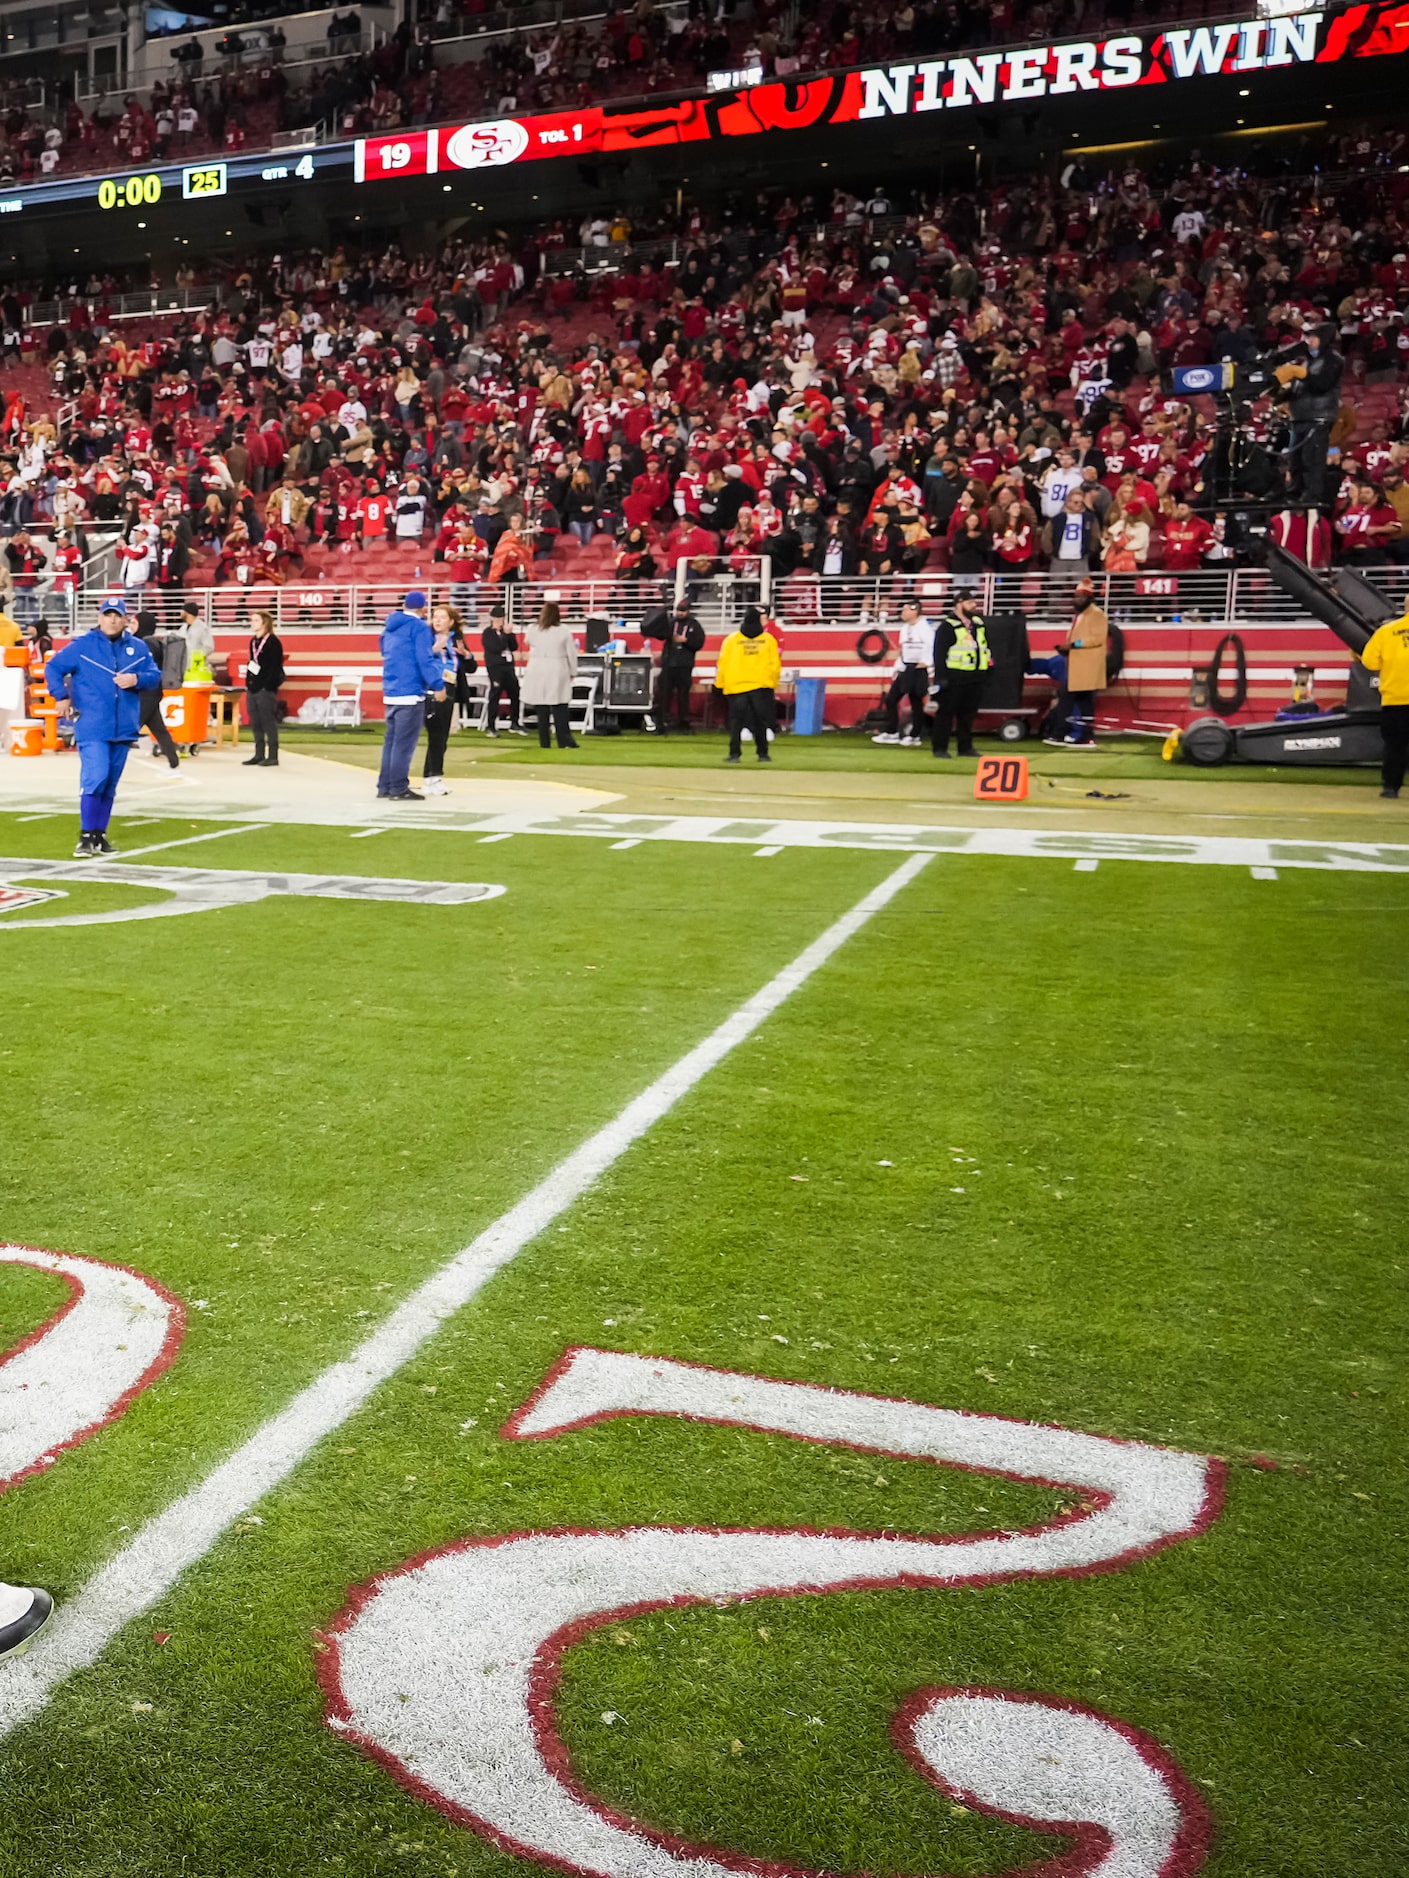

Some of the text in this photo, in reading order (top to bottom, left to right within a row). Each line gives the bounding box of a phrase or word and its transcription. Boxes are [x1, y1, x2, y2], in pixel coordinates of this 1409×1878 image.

[858, 13, 1323, 119] NINERS WIN
[379, 143, 411, 169] 19
[539, 130, 569, 144] TOL
[573, 124, 582, 141] 1
[262, 155, 314, 181] QTR 4
[98, 175, 161, 210] 0:00
[191, 171, 219, 193] 25
[0, 199, 22, 213] THE
[1138, 444, 1160, 463] 97
[368, 503, 380, 520] 8
[1142, 578, 1171, 594] 141
[299, 593, 323, 606] 140
[158, 696, 184, 727] G
[980, 760, 1020, 794] 20
